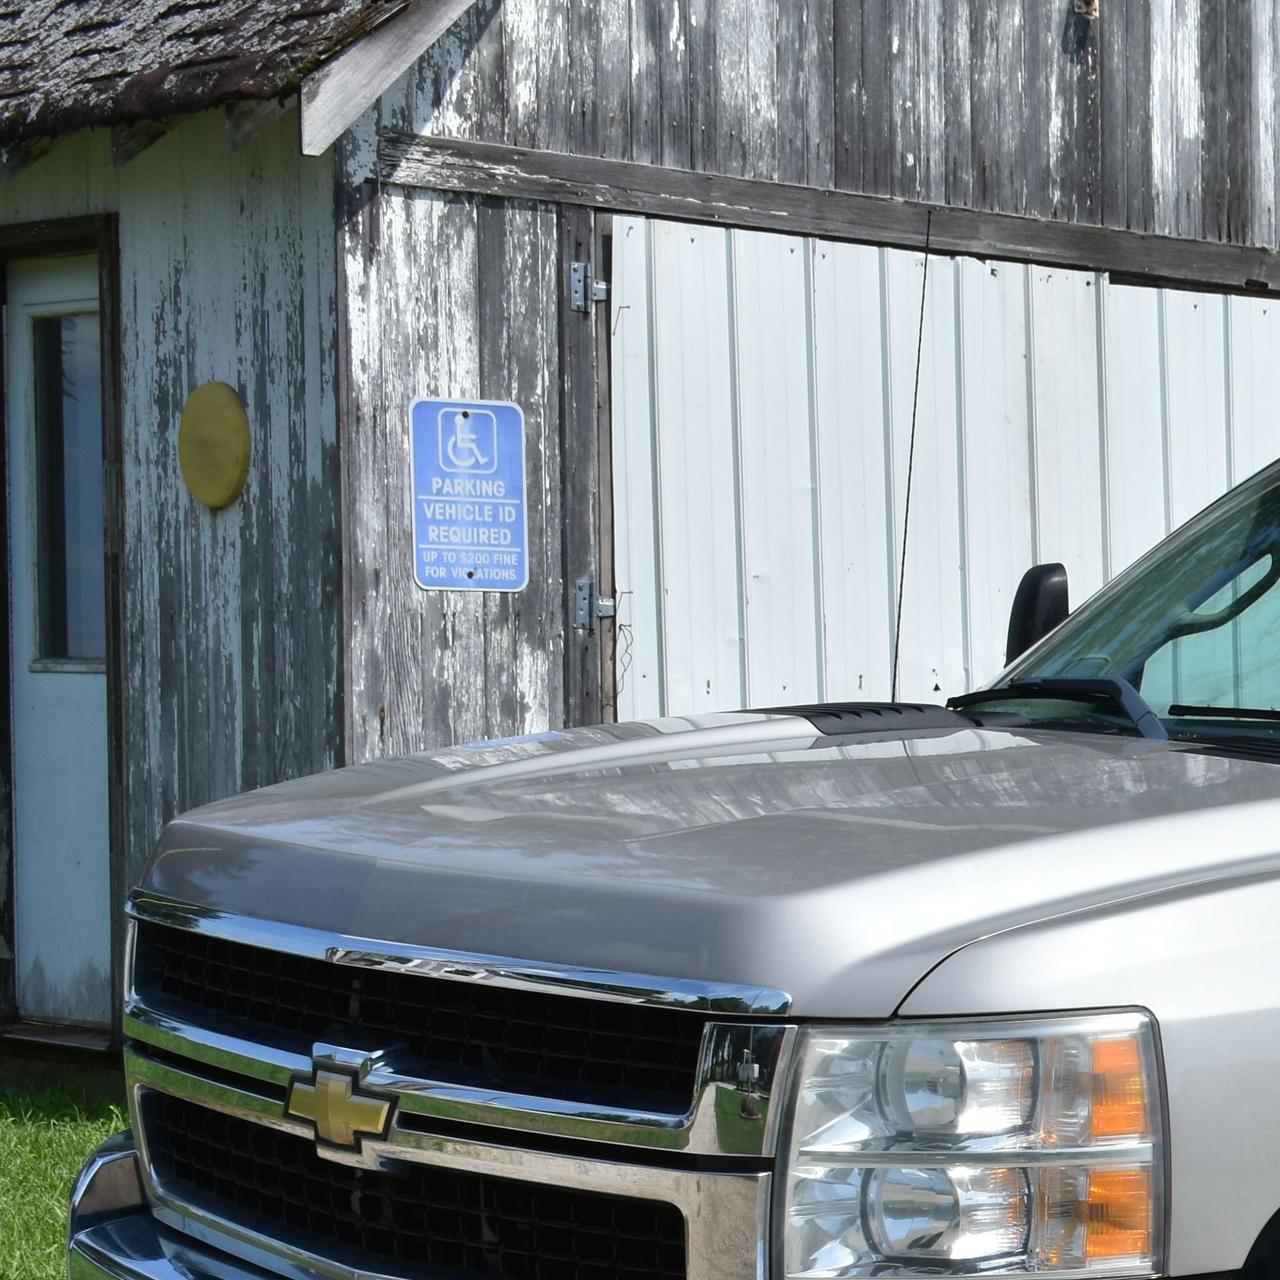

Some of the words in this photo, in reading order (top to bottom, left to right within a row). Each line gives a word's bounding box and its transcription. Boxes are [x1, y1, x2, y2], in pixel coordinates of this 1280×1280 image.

[432, 477, 505, 497] PARKING
[424, 503, 493, 521] VEHICLE
[499, 506, 517, 523] ID
[429, 526, 511, 544] REQUIRED
[423, 551, 438, 563] UP
[442, 552, 457, 564] TO
[460, 552, 490, 565] $200
[493, 553, 518, 566] FINE
[425, 566, 447, 578] FOR
[451, 567, 516, 579] VIOATIONS
